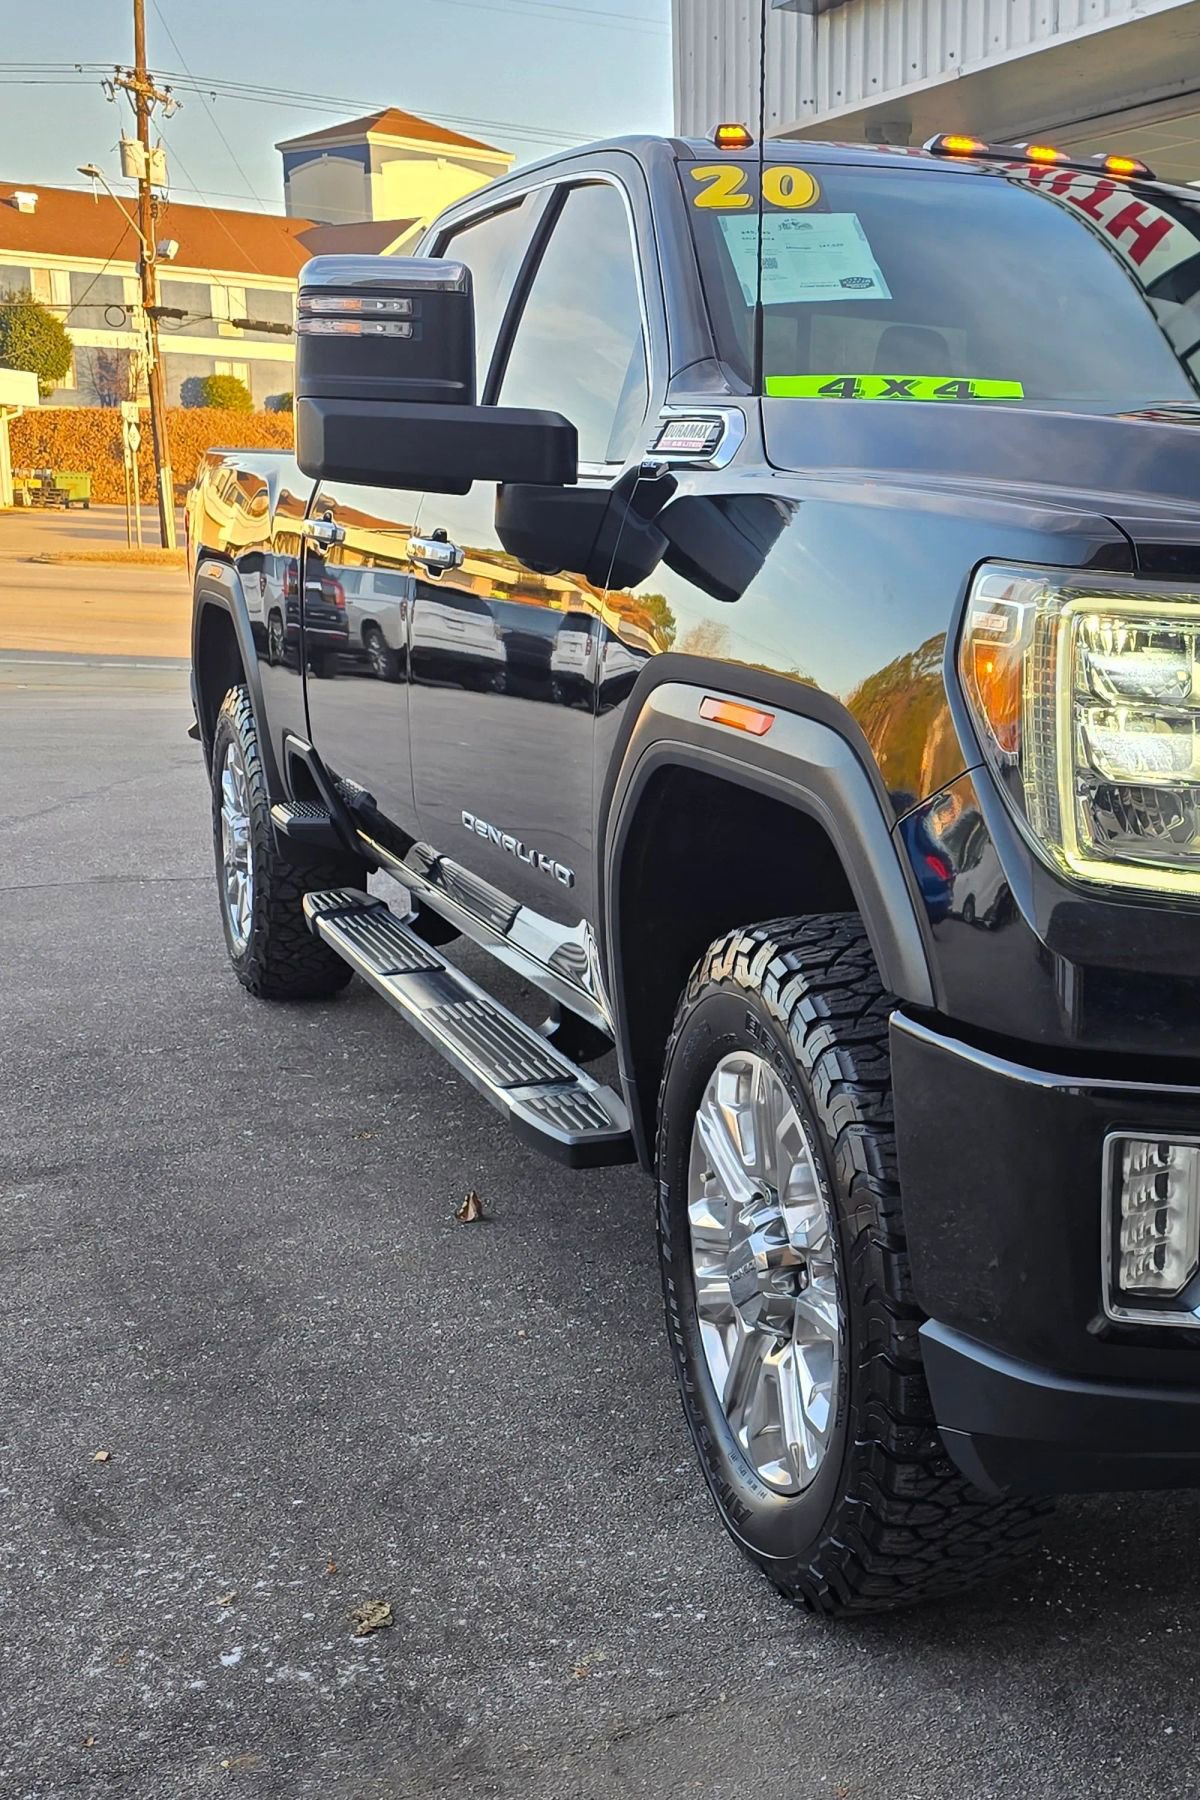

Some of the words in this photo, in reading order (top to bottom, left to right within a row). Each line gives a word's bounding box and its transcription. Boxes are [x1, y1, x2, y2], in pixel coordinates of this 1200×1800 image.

[690, 164, 820, 208] 20
[664, 424, 711, 438] DURAMAX
[461, 810, 539, 868] DENALI
[538, 853, 576, 888] HD
